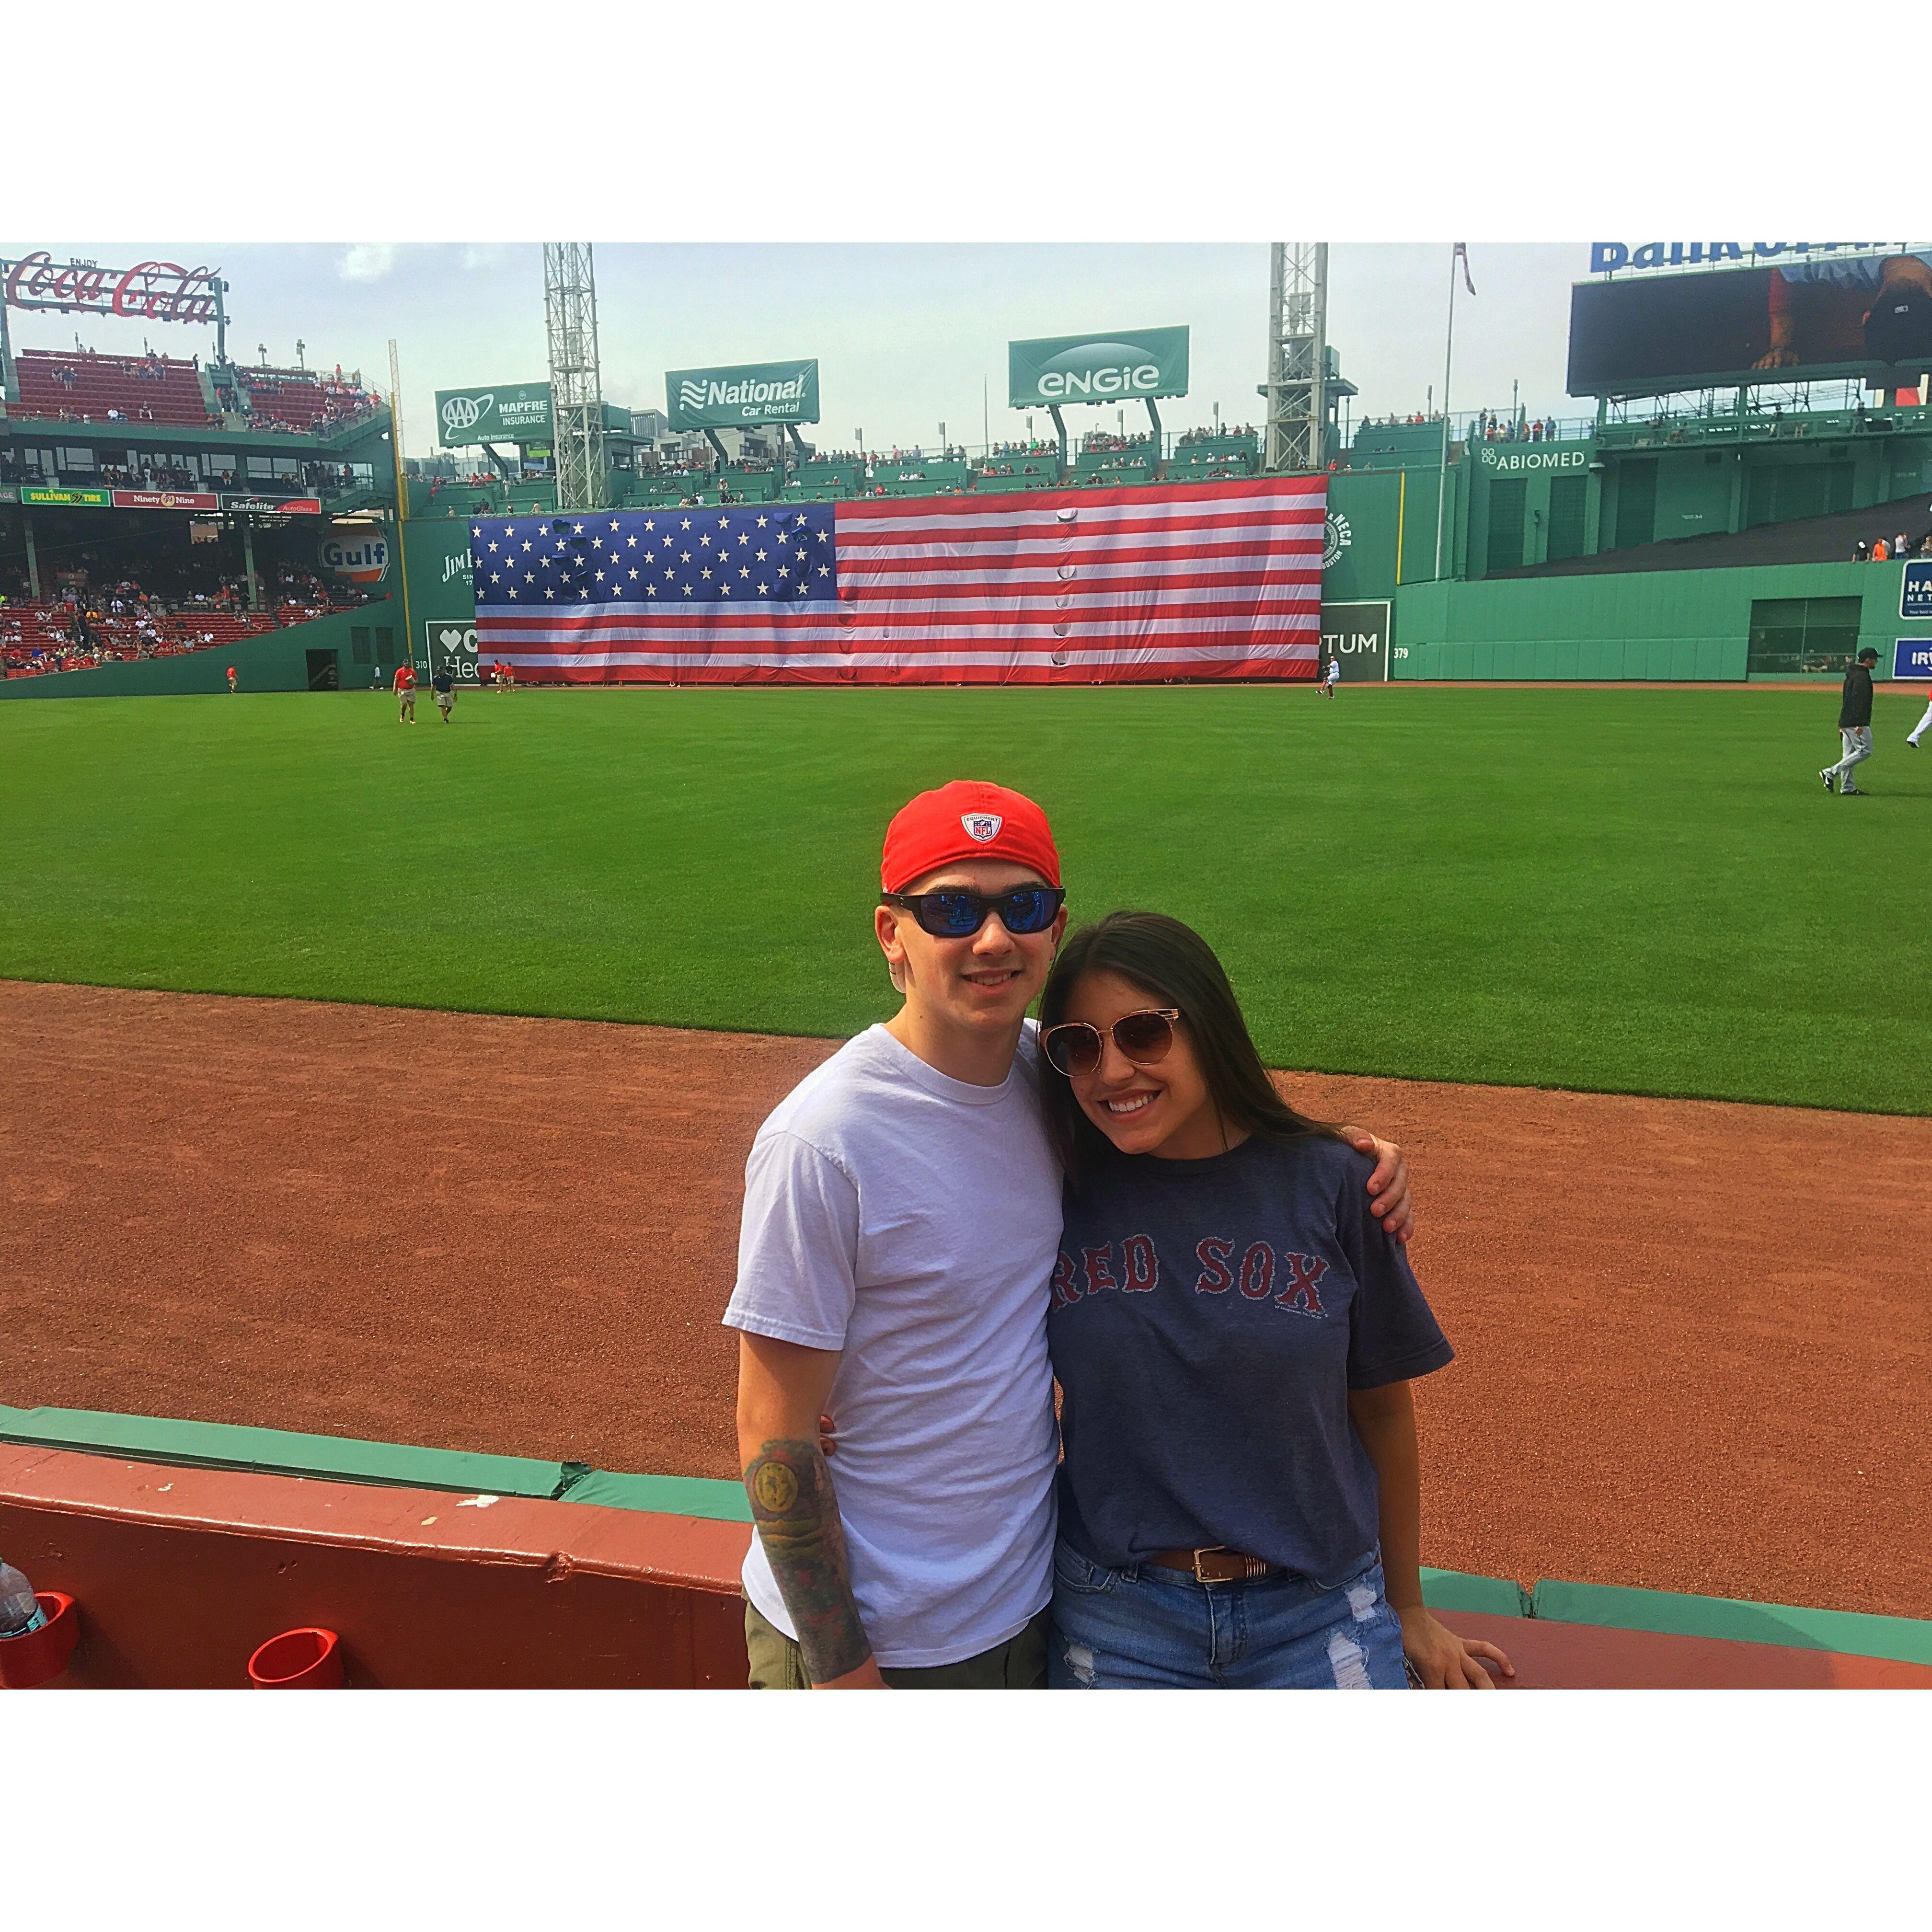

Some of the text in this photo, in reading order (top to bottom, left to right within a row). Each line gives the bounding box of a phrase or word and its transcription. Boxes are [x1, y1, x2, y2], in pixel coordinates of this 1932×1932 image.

[70, 257, 97, 267] ENJOY
[6, 251, 221, 322] Coca-Cola
[446, 398, 476, 427] AAA
[499, 400, 548, 414] MAPFRE
[742, 402, 800, 416] Car Rental
[503, 414, 546, 426] INSURANCE
[1496, 451, 1585, 471] ABIOMED
[30, 490, 102, 502] SULLIVAN TIRE
[133, 495, 160, 504] Ninety
[230, 502, 275, 510] Safelite
[1333, 513, 1352, 546] NECA
[323, 542, 385, 565] Gulf
[442, 553, 465, 582] JIM
[1908, 580, 1932, 592] HA
[1393, 648, 1408, 659] 379
[415, 660, 427, 669] 310
[975, 827, 990, 836] NFL
[1053, 1233, 1331, 1315] RED SOX
